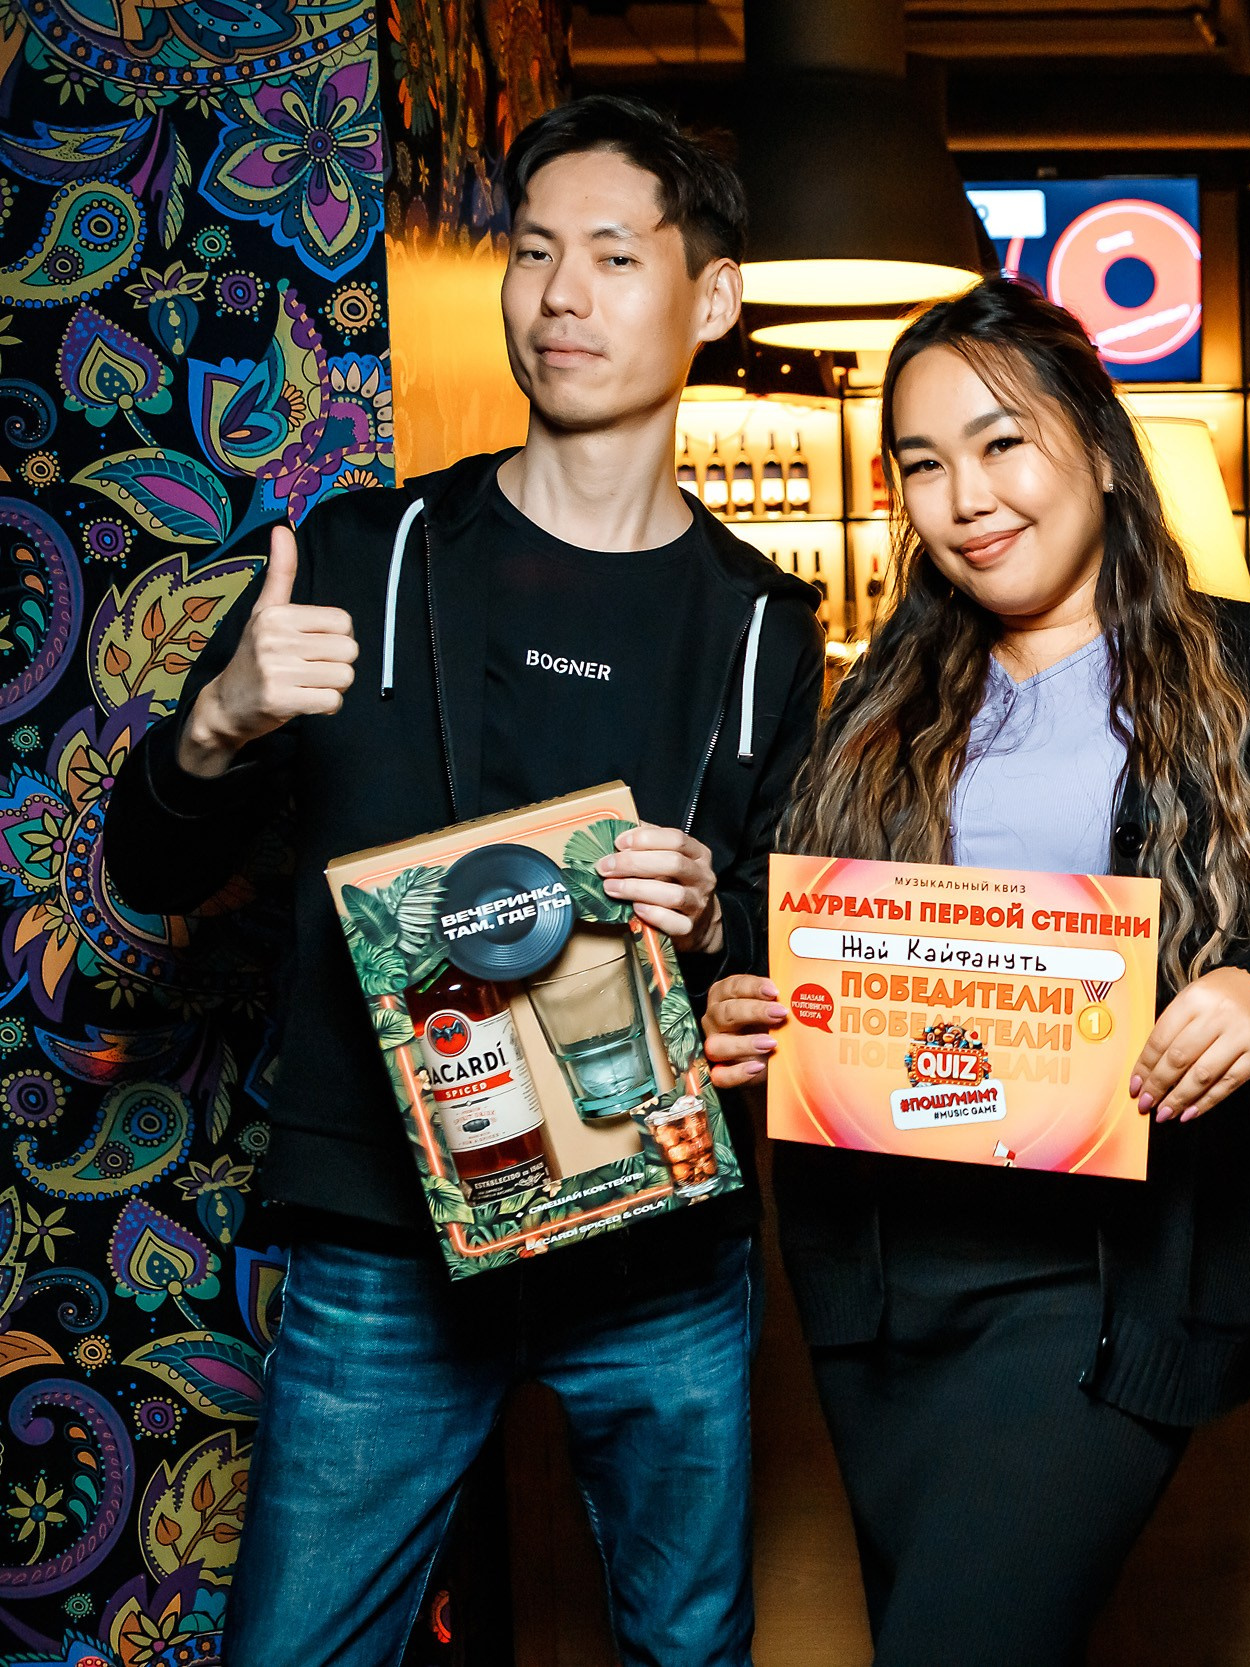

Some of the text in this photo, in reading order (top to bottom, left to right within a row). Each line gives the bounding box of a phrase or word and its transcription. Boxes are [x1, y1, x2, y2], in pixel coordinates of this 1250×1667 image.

[526, 649, 612, 681] BOGNER
[894, 876, 1026, 894] МУЗЫКАЛЬНЫЙ КВИЗ
[441, 882, 567, 928] ВЕЧЕРИНКА
[496, 905, 537, 925] ГДЕ
[539, 894, 572, 912] ТЫ
[779, 891, 1151, 938] ЛАУРЕАТЫ ПЕРВОЙ СТЕПЕНИ
[907, 938, 1047, 972] Кайфануть
[841, 970, 1075, 1016] ПОБЕДИТЕЛИ!
[1087, 1011, 1101, 1035] 1
[917, 1051, 978, 1081] QUIZ
[445, 1082, 487, 1099] SPICED
[900, 1087, 999, 1113] #ПОШУМИМ?
[933, 1104, 997, 1120] #MUSIC GAME
[528, 1190, 583, 1215] СМЕШАЙ
[583, 1172, 645, 1198] КОКТЕЙЛЬ
[578, 1213, 622, 1234] SPICED
[622, 1211, 633, 1220] &
